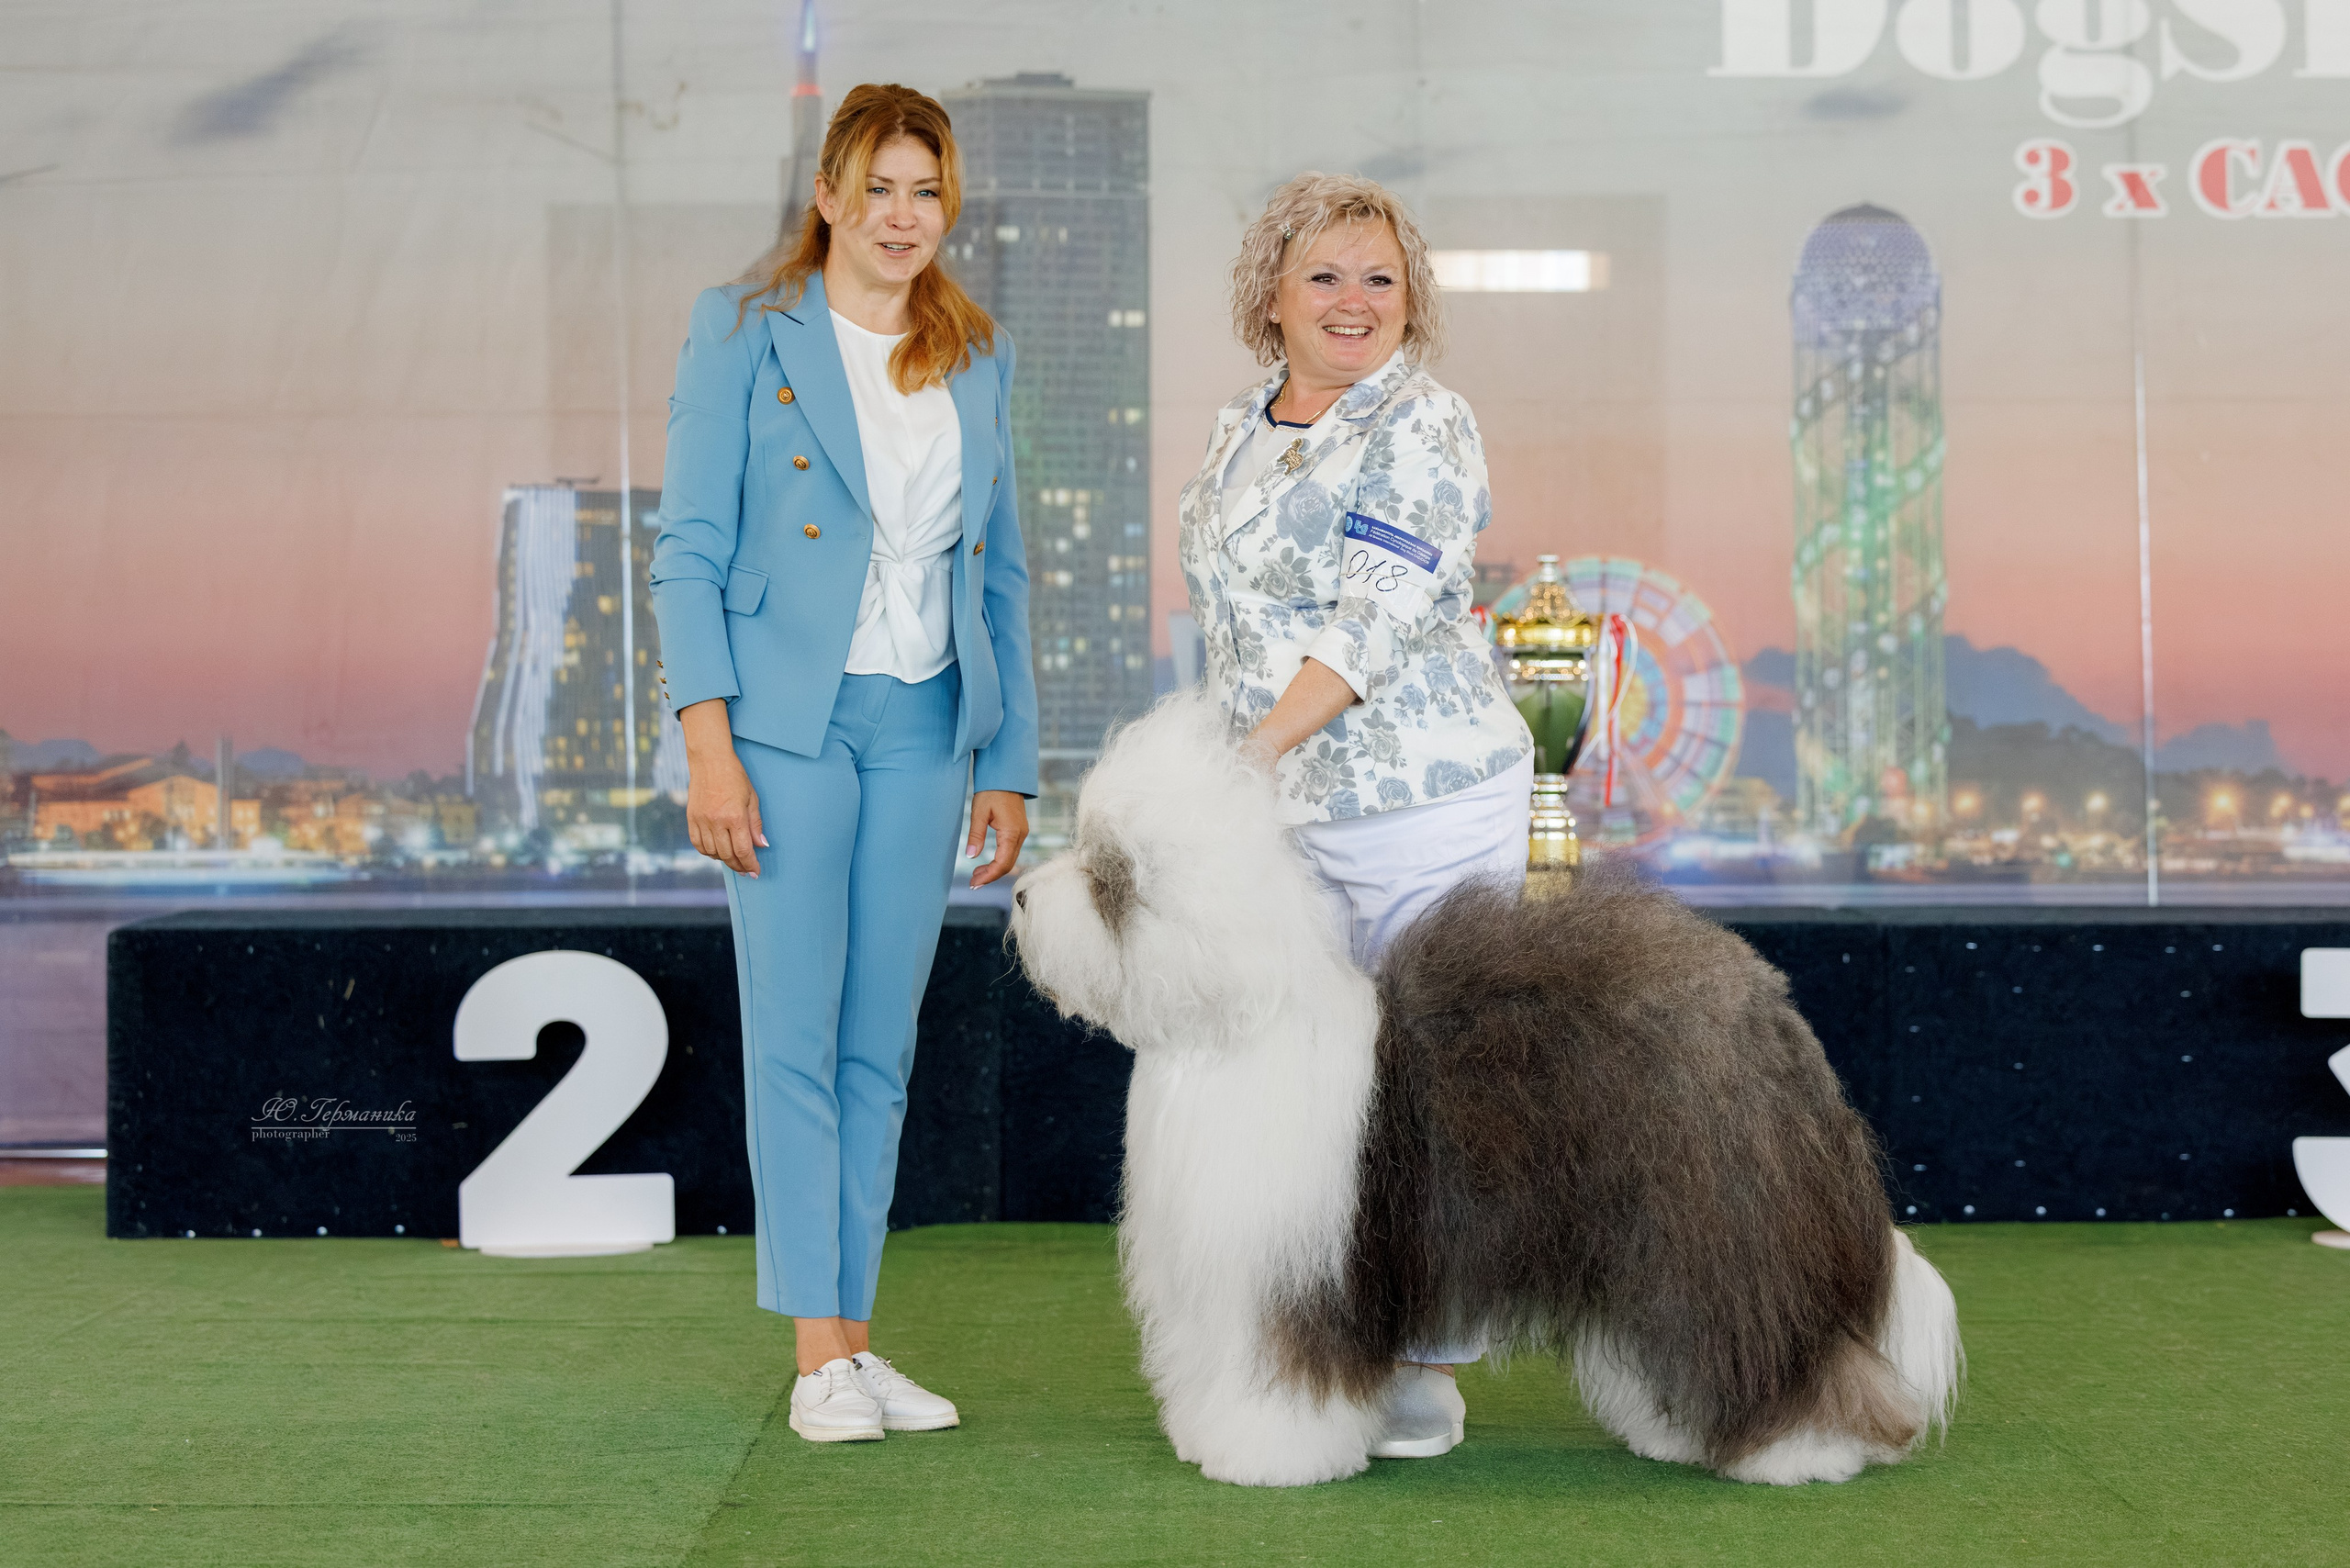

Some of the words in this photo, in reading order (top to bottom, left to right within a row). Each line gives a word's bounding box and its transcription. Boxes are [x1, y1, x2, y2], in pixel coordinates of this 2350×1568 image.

[2013, 139, 2078, 218] 3
[2103, 163, 2167, 218] x
[1347, 550, 1408, 592] 018
[453, 949, 675, 1256] 2
